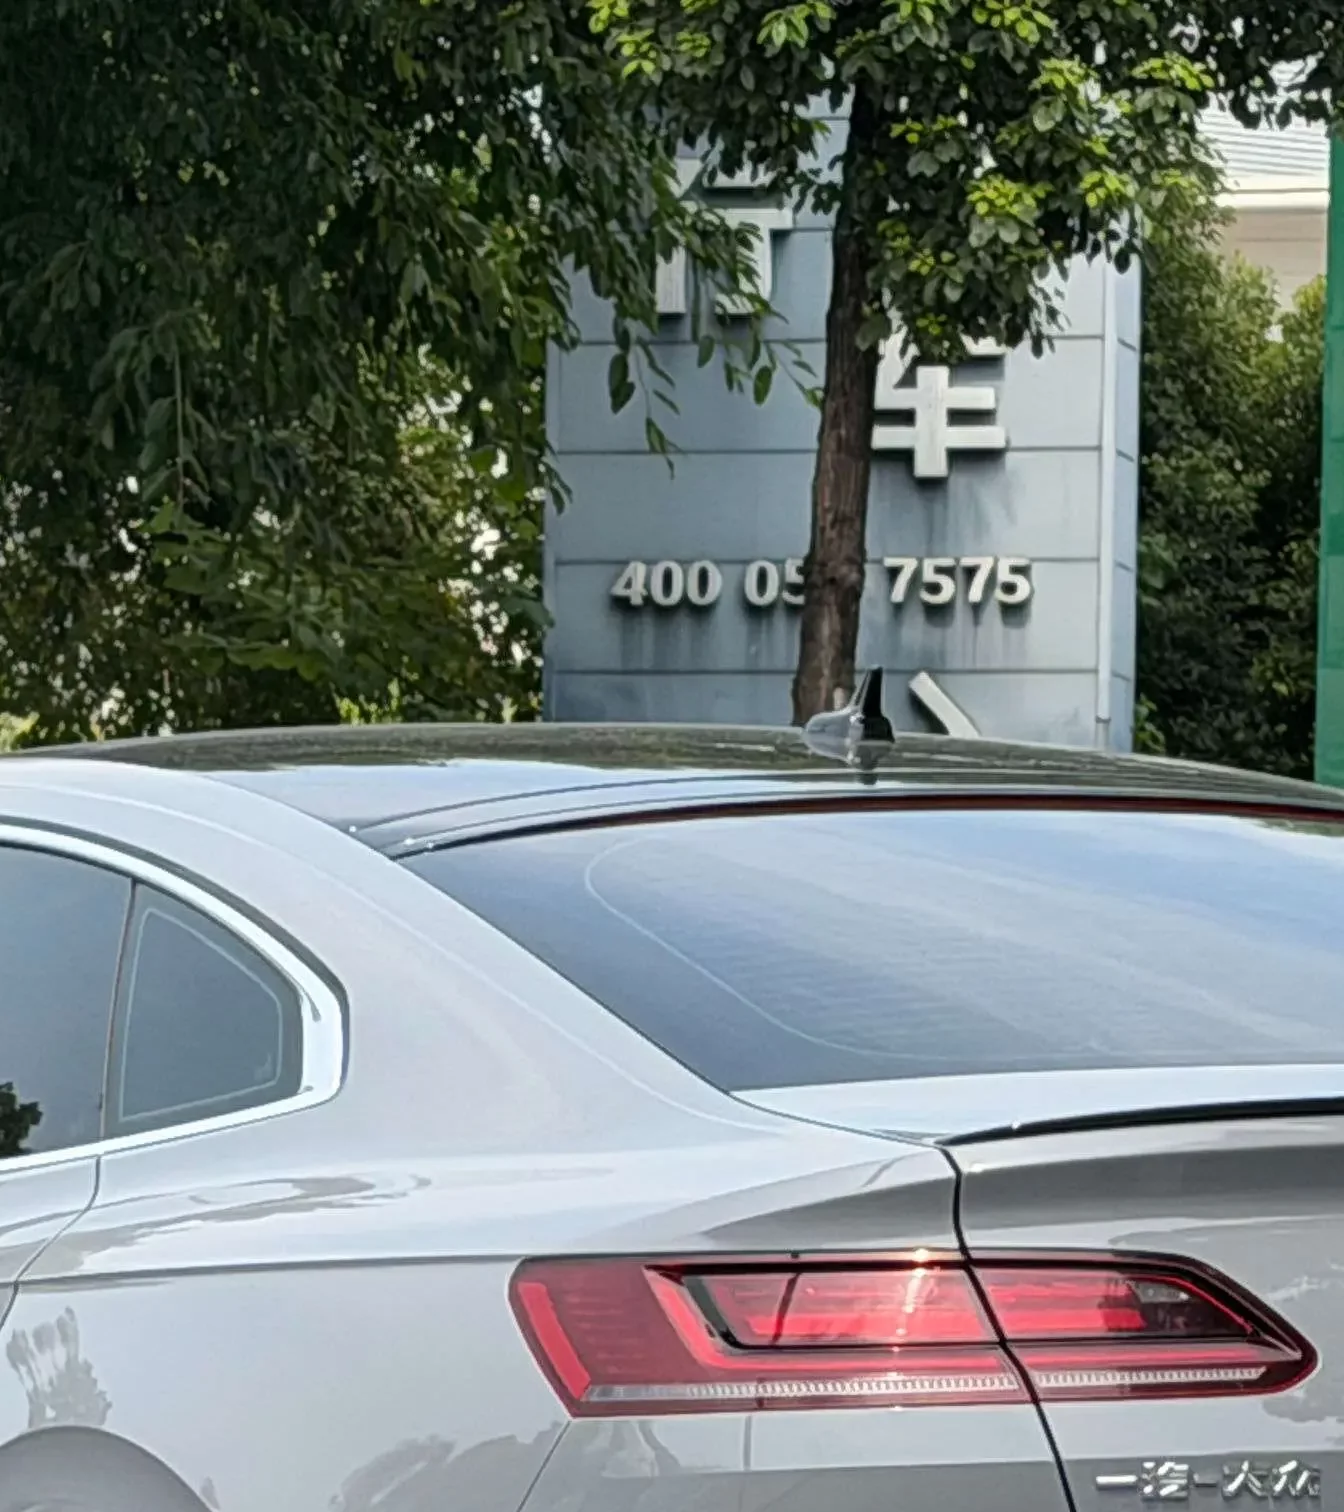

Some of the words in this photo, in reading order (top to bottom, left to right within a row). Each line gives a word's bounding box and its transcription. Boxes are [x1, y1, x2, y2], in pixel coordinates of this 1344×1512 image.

[610, 560, 723, 607] 400
[744, 558, 806, 607] 05
[883, 556, 1033, 606] 7575
